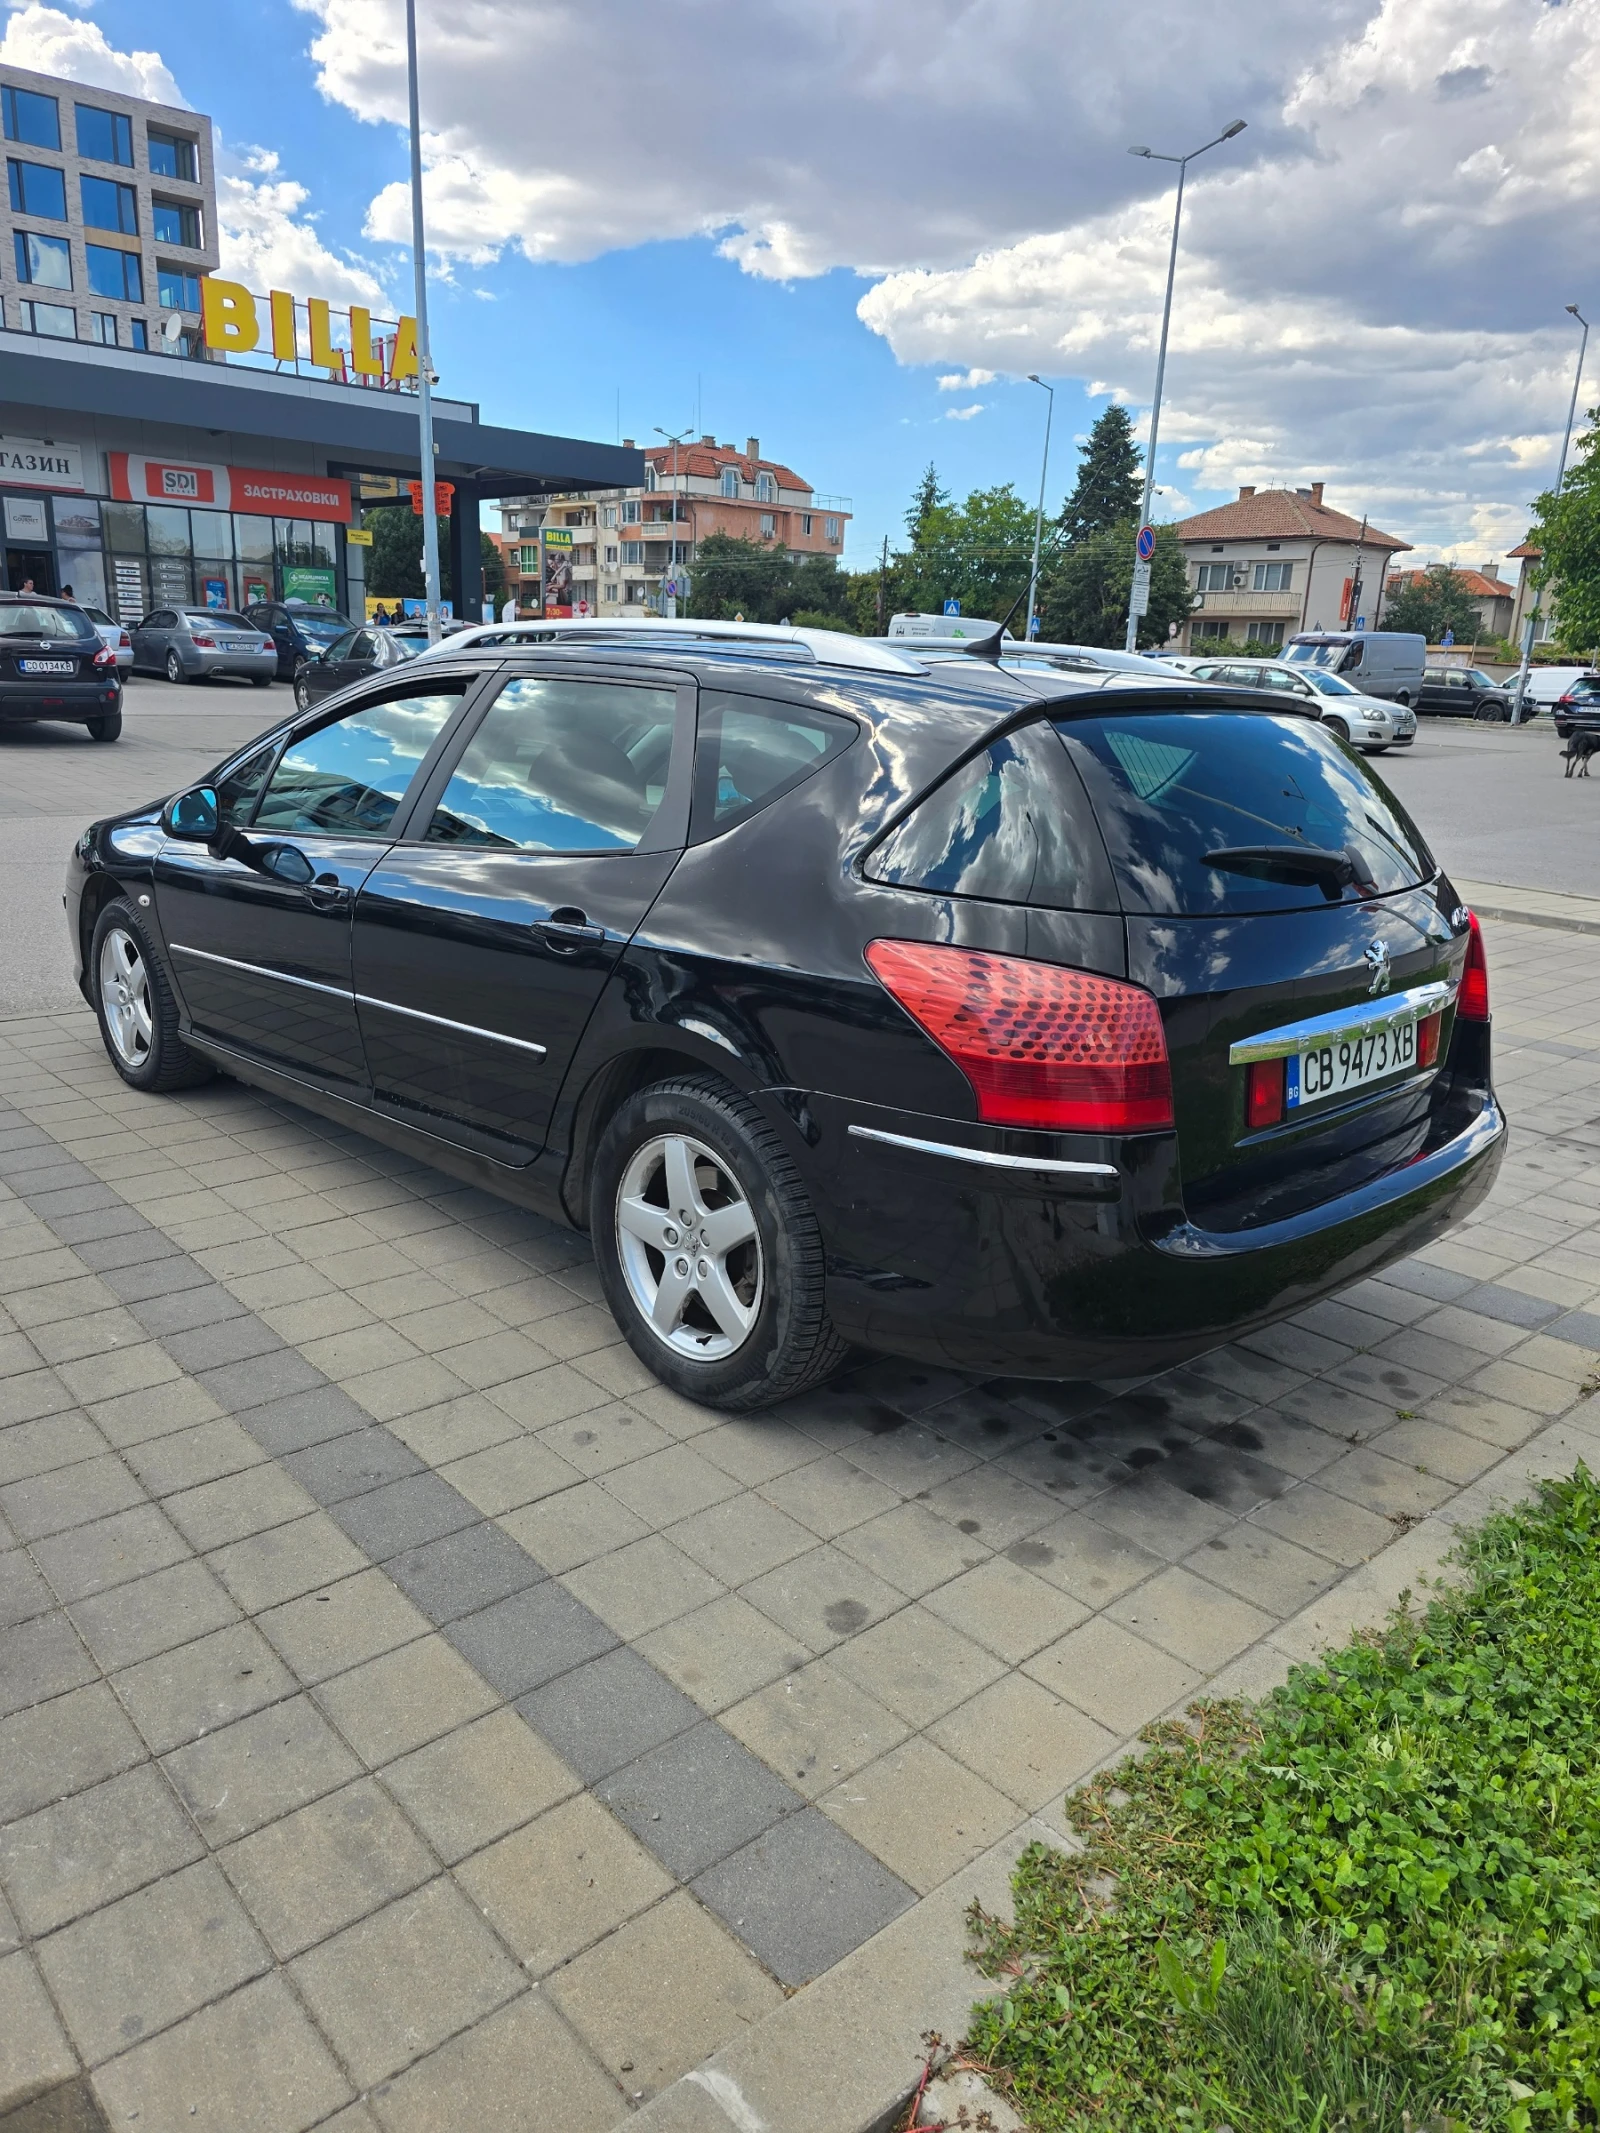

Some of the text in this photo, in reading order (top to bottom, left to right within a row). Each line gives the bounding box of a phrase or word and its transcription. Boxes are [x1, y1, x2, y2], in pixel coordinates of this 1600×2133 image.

[200, 276, 419, 380] BILLA
[165, 472, 195, 490] SDI
[243, 484, 339, 507] ЗАСТРАХОВКИ
[546, 531, 571, 544] BILLA
[1304, 1023, 1413, 1095] CB 9473 XB
[1288, 1086, 1299, 1100] BG
